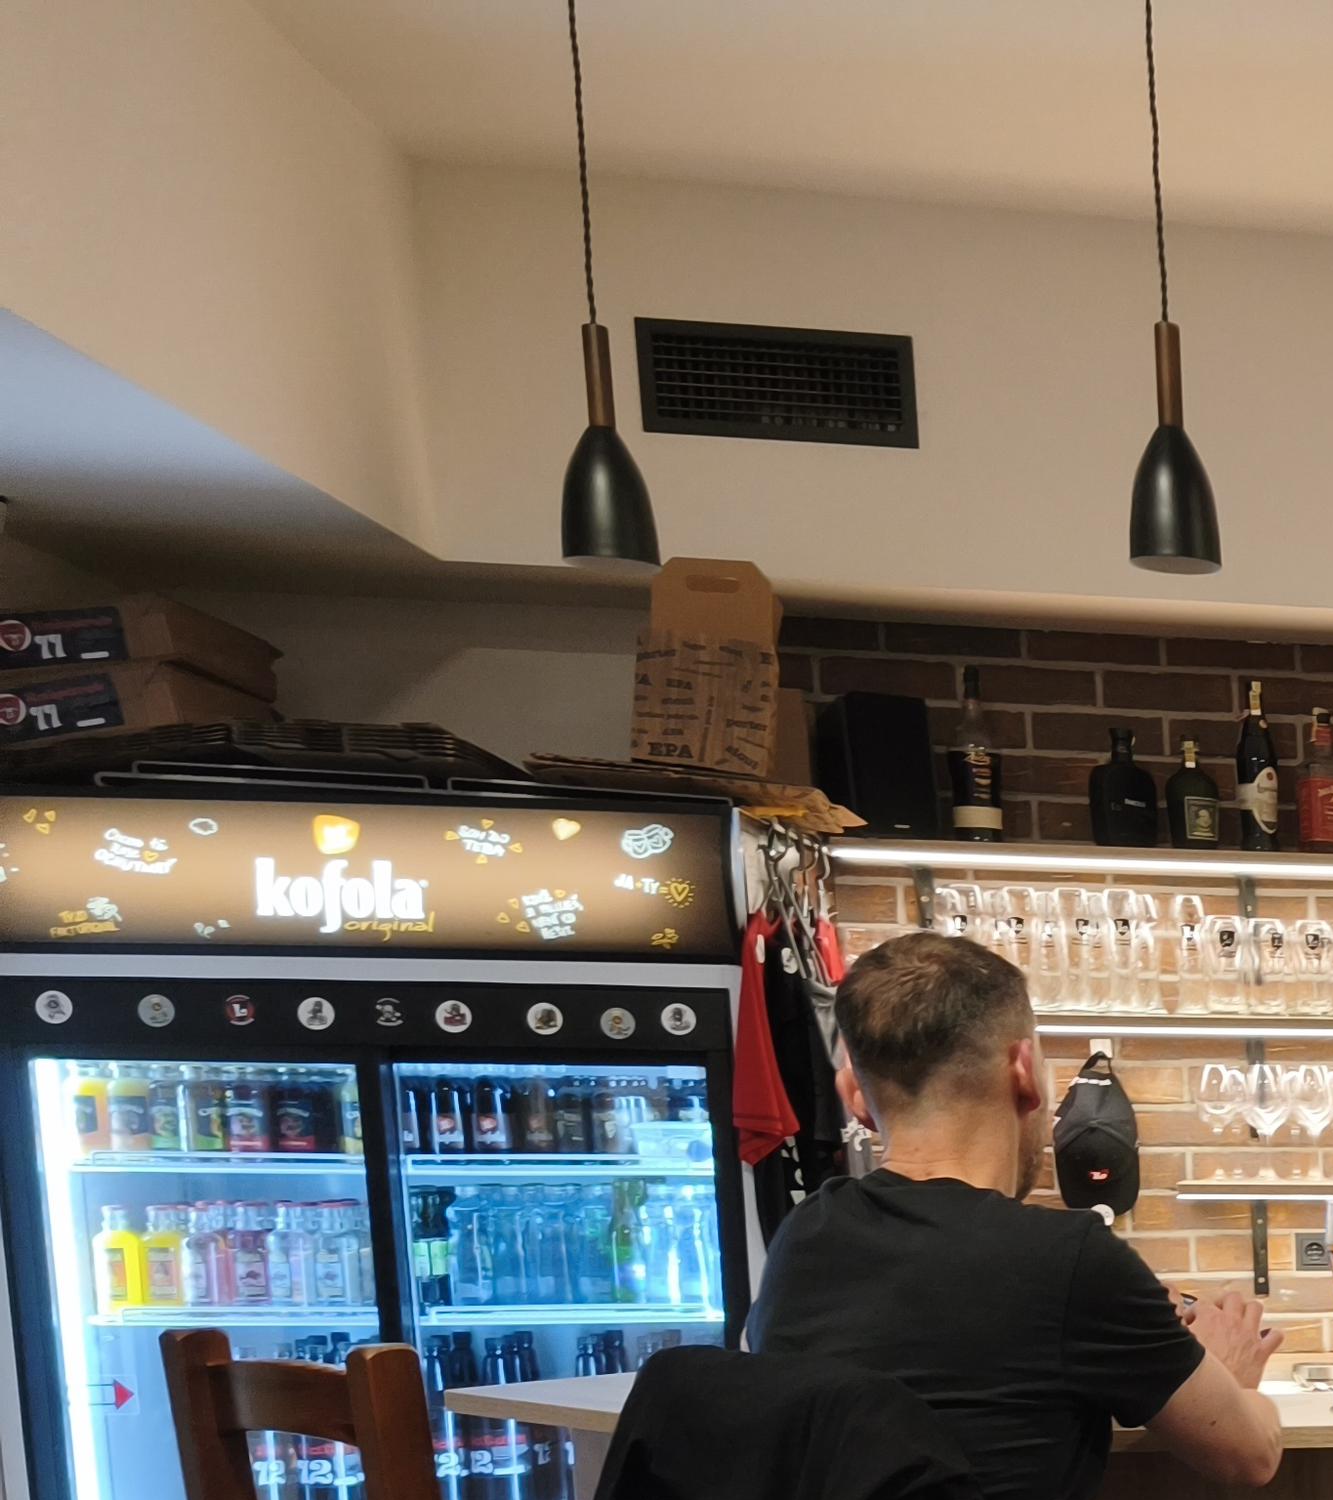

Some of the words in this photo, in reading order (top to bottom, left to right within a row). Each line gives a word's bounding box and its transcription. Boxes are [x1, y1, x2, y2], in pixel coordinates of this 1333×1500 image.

[647, 742, 694, 759] EPA
[255, 857, 426, 933] kofola
[343, 911, 436, 941] original
[253, 1460, 286, 1486] 12
